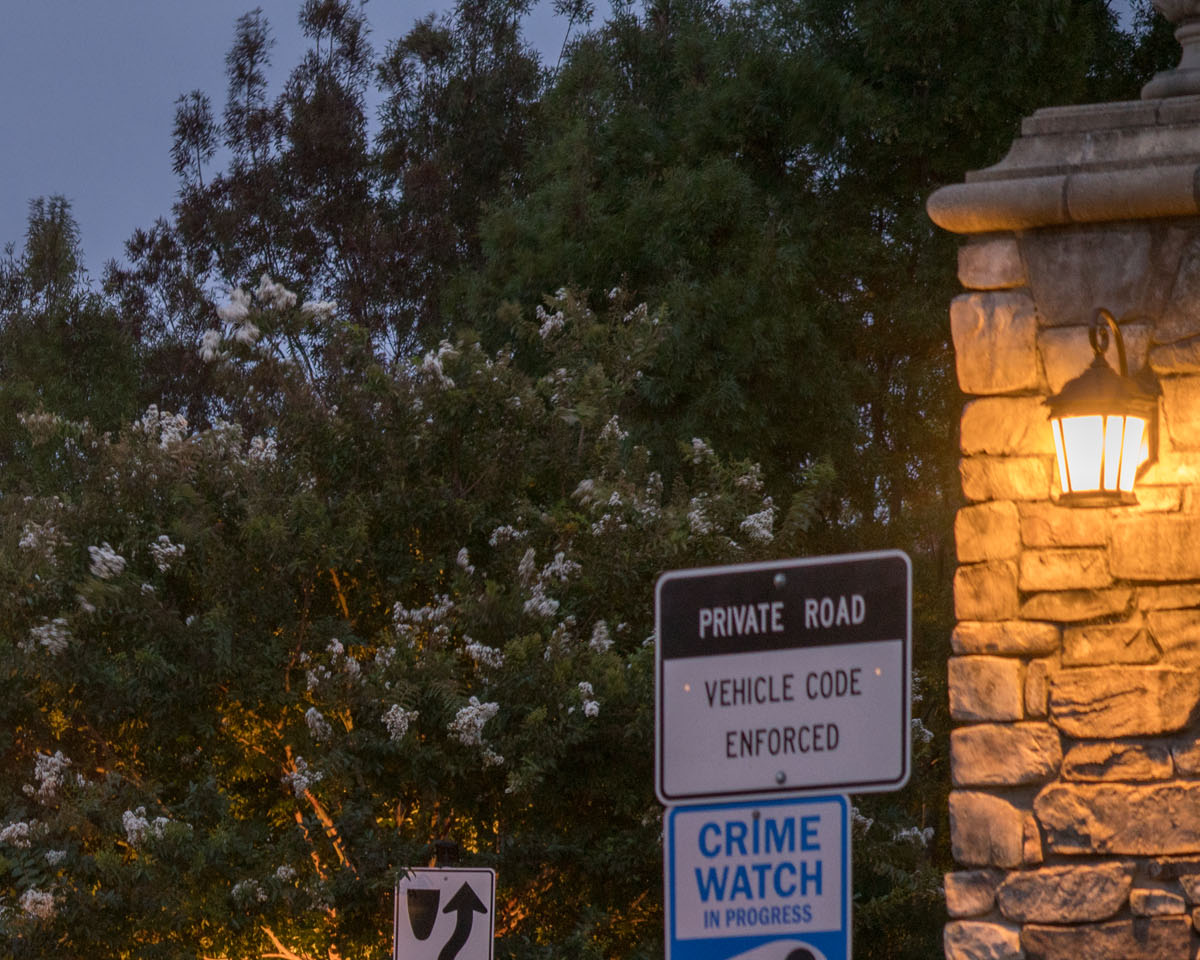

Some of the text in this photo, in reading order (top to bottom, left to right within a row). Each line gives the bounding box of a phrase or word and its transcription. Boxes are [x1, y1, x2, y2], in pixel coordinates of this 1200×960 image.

[698, 594, 866, 639] PRIVATE ROAD
[704, 668, 862, 708] VEHICLE CODE
[726, 723, 839, 759] ENFORCED
[698, 815, 821, 859] CRIME
[694, 860, 823, 903] WATCH
[703, 904, 813, 929] IN PROGRESS
